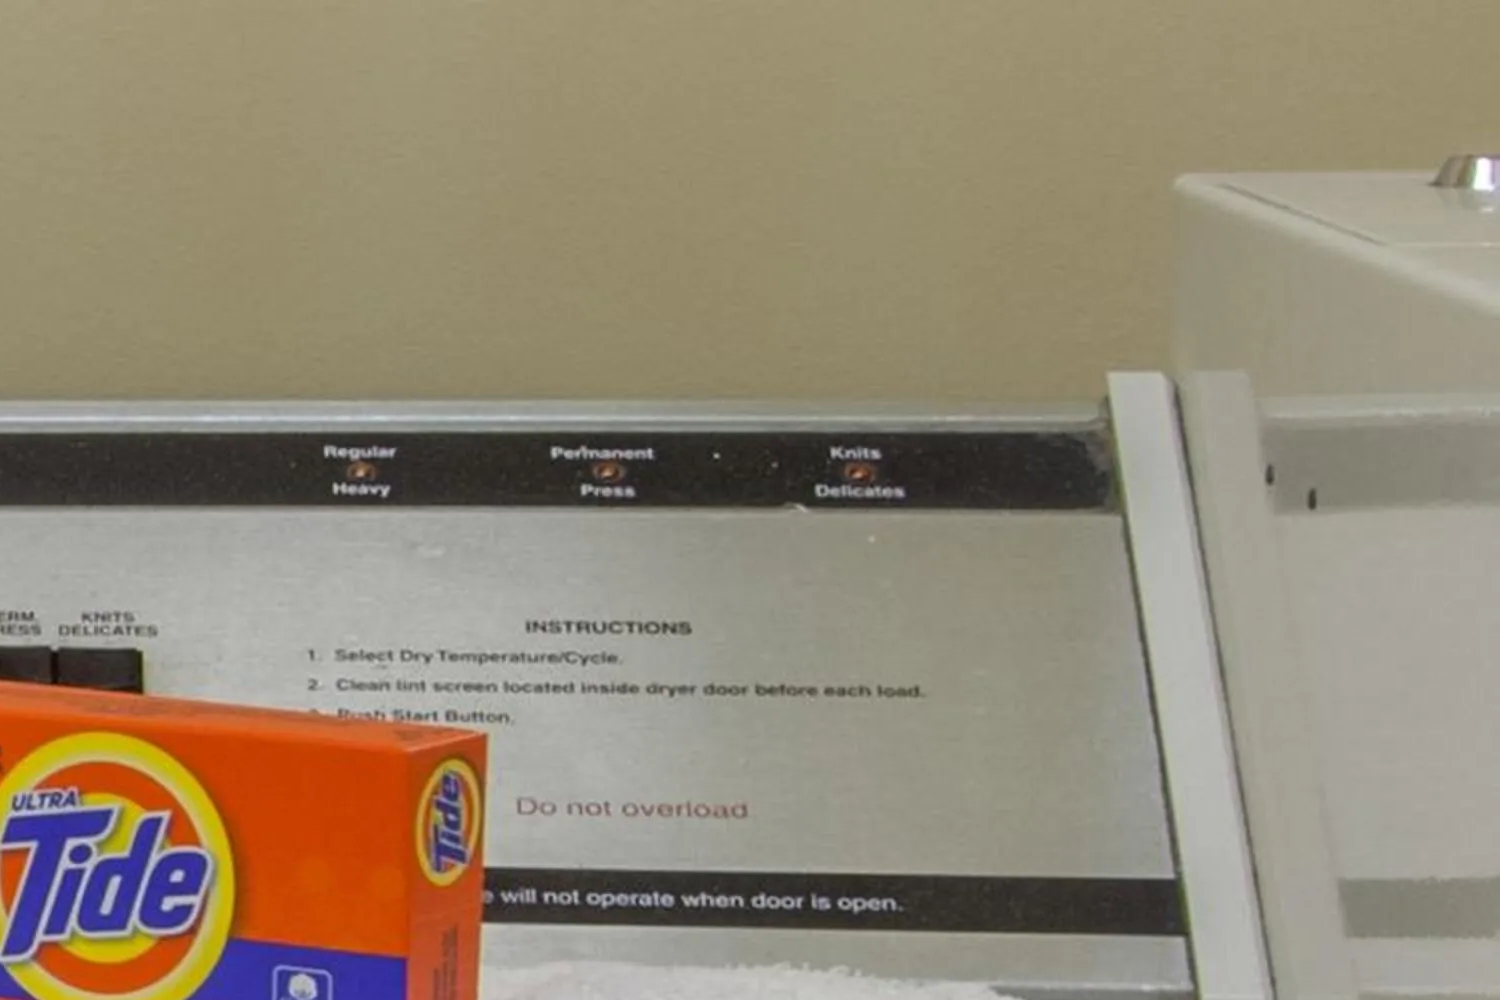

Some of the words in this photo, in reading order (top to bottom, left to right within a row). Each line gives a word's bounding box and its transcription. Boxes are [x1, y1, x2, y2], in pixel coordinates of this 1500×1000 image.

[324, 445, 397, 460] Regular
[551, 446, 654, 460] Permanent
[830, 446, 882, 460] Knits
[332, 483, 390, 498] Heavy
[580, 484, 636, 497] Press
[815, 484, 905, 498] Delicates
[81, 611, 135, 622] KNITS
[58, 624, 158, 636] DELICATES
[526, 621, 692, 635] INSTRUCTIONS
[307, 650, 322, 661] 1.
[334, 649, 393, 662] Select
[401, 650, 434, 666] Dry
[437, 650, 623, 666] Temperature/Cycle.
[336, 678, 390, 692] Clean
[397, 679, 426, 692] lint
[433, 682, 498, 693] screen
[504, 680, 575, 694] located
[581, 681, 639, 695] inside
[646, 682, 696, 698] dryer
[703, 683, 748, 696] door
[755, 683, 818, 697] before
[824, 684, 871, 698] each
[877, 684, 926, 698] load.
[393, 709, 438, 722] Start
[446, 710, 515, 726] Button.
[12, 789, 78, 811] ULTRA
[516, 797, 556, 816] Do
[567, 799, 612, 817] not
[622, 800, 749, 819] overload
[431, 772, 467, 873] Tide
[500, 888, 537, 904] will
[543, 890, 579, 905] not
[586, 891, 675, 909] operate
[681, 892, 744, 907] when
[751, 892, 803, 909] door
[811, 893, 831, 909] is
[837, 896, 904, 914] open.
